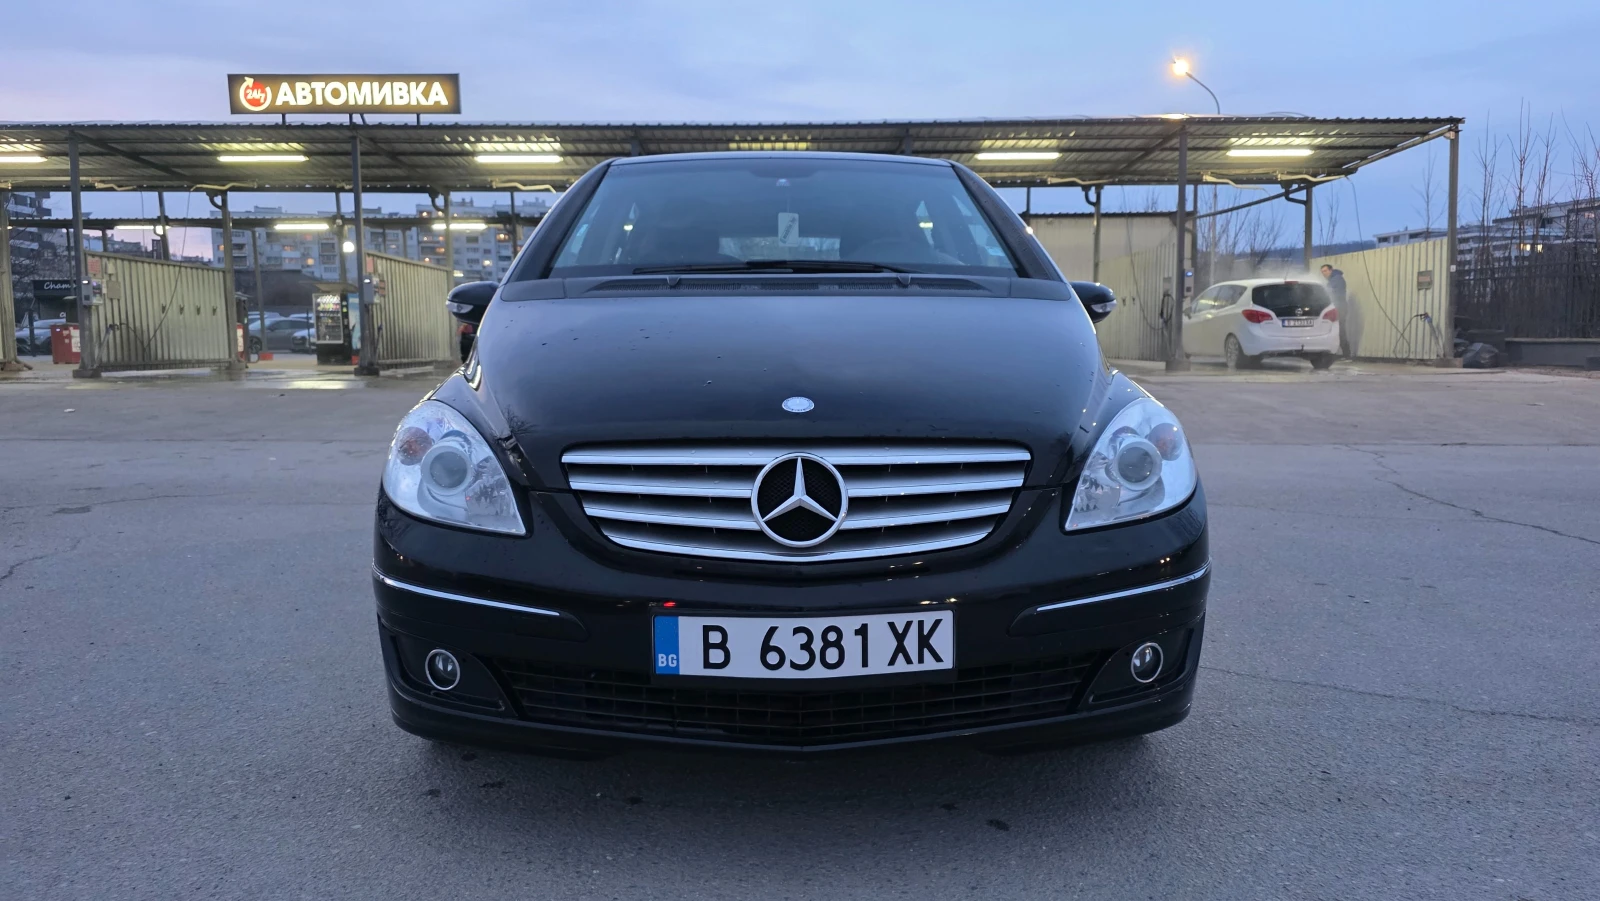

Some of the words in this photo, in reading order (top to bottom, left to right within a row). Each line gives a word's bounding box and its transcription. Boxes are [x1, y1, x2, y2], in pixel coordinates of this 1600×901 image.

[275, 82, 448, 105] АВТОМИВКА
[702, 624, 731, 670] B
[759, 622, 869, 671] 6381
[887, 618, 945, 667] XK
[658, 653, 678, 668] BG
